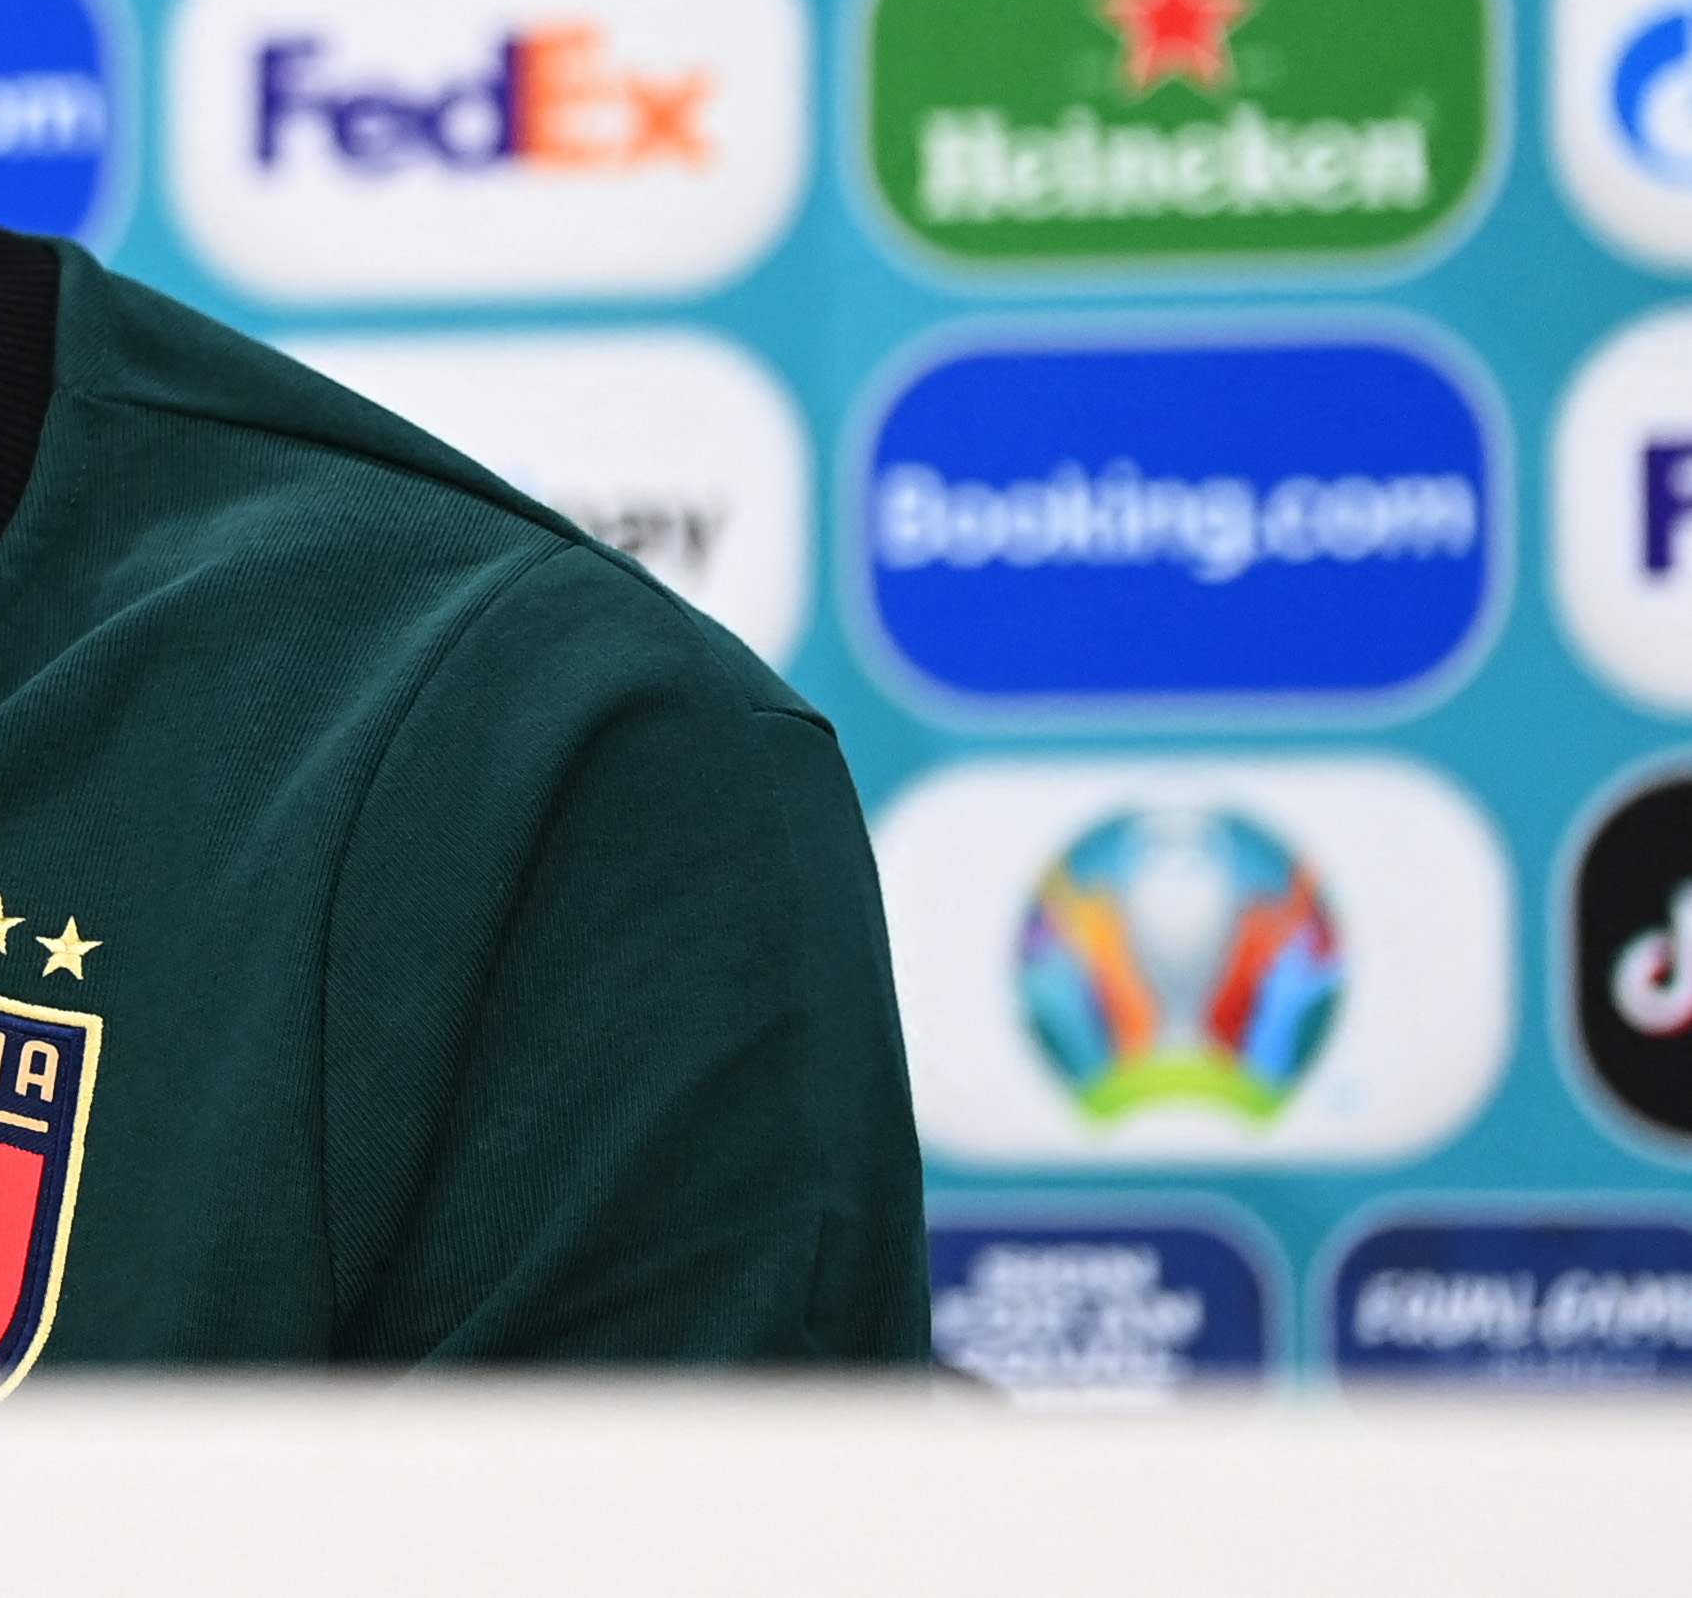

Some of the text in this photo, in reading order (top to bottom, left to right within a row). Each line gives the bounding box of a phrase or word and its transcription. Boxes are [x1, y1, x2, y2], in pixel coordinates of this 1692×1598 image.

[252, 18, 720, 177] FedEx
[914, 100, 1432, 225] Heineken
[874, 452, 1478, 586] Booking.com
